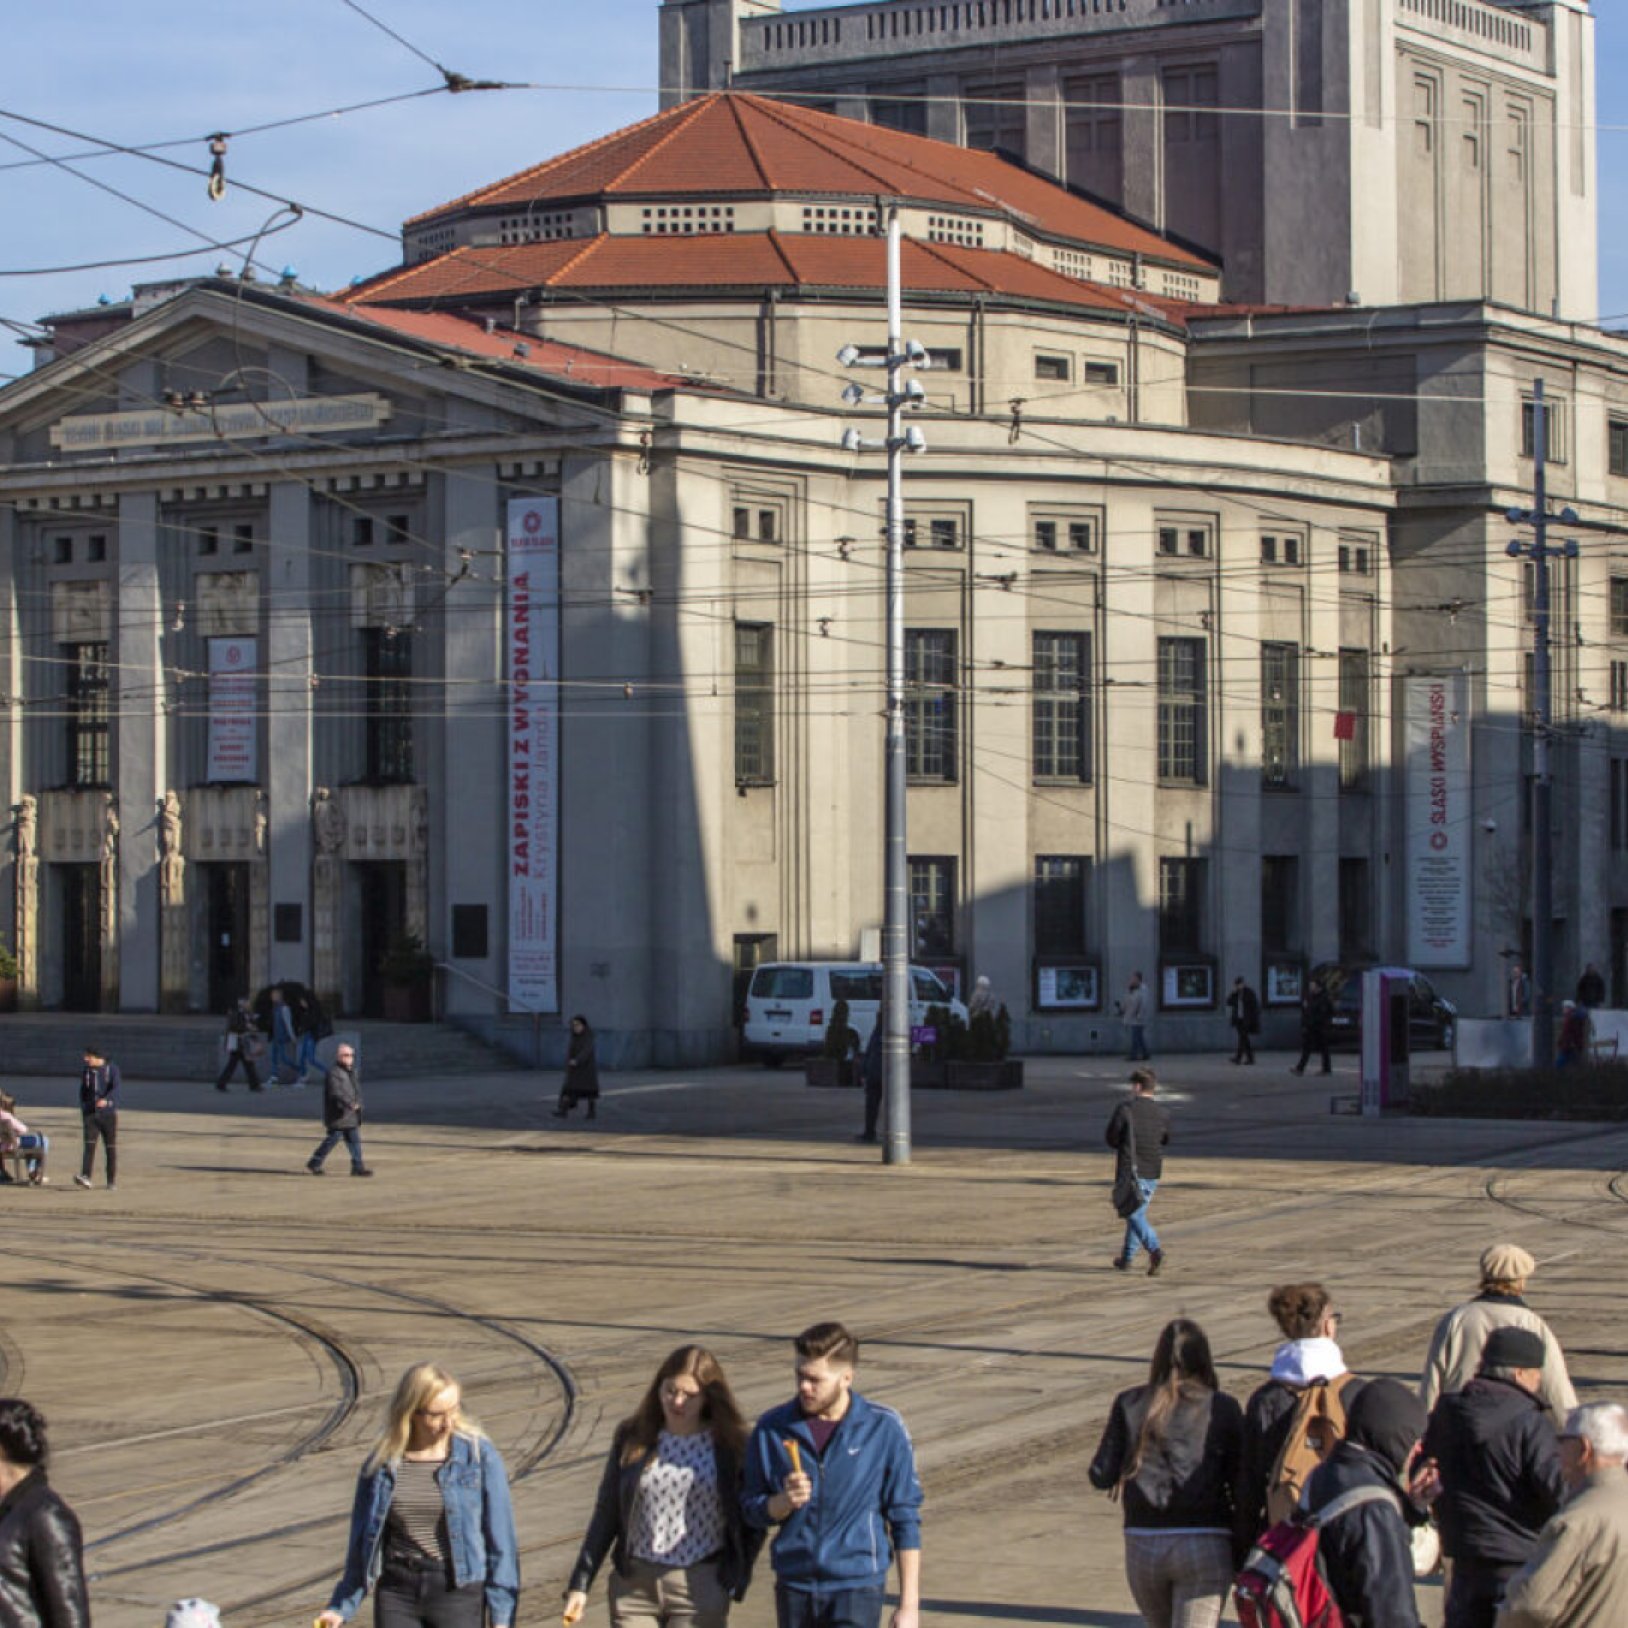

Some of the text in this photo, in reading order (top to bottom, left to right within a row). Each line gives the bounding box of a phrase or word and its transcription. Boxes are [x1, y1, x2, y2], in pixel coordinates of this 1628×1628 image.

[513, 738, 529, 755] Z
[513, 760, 529, 878] ZAPISKI
[534, 780, 551, 880] Krystyna
